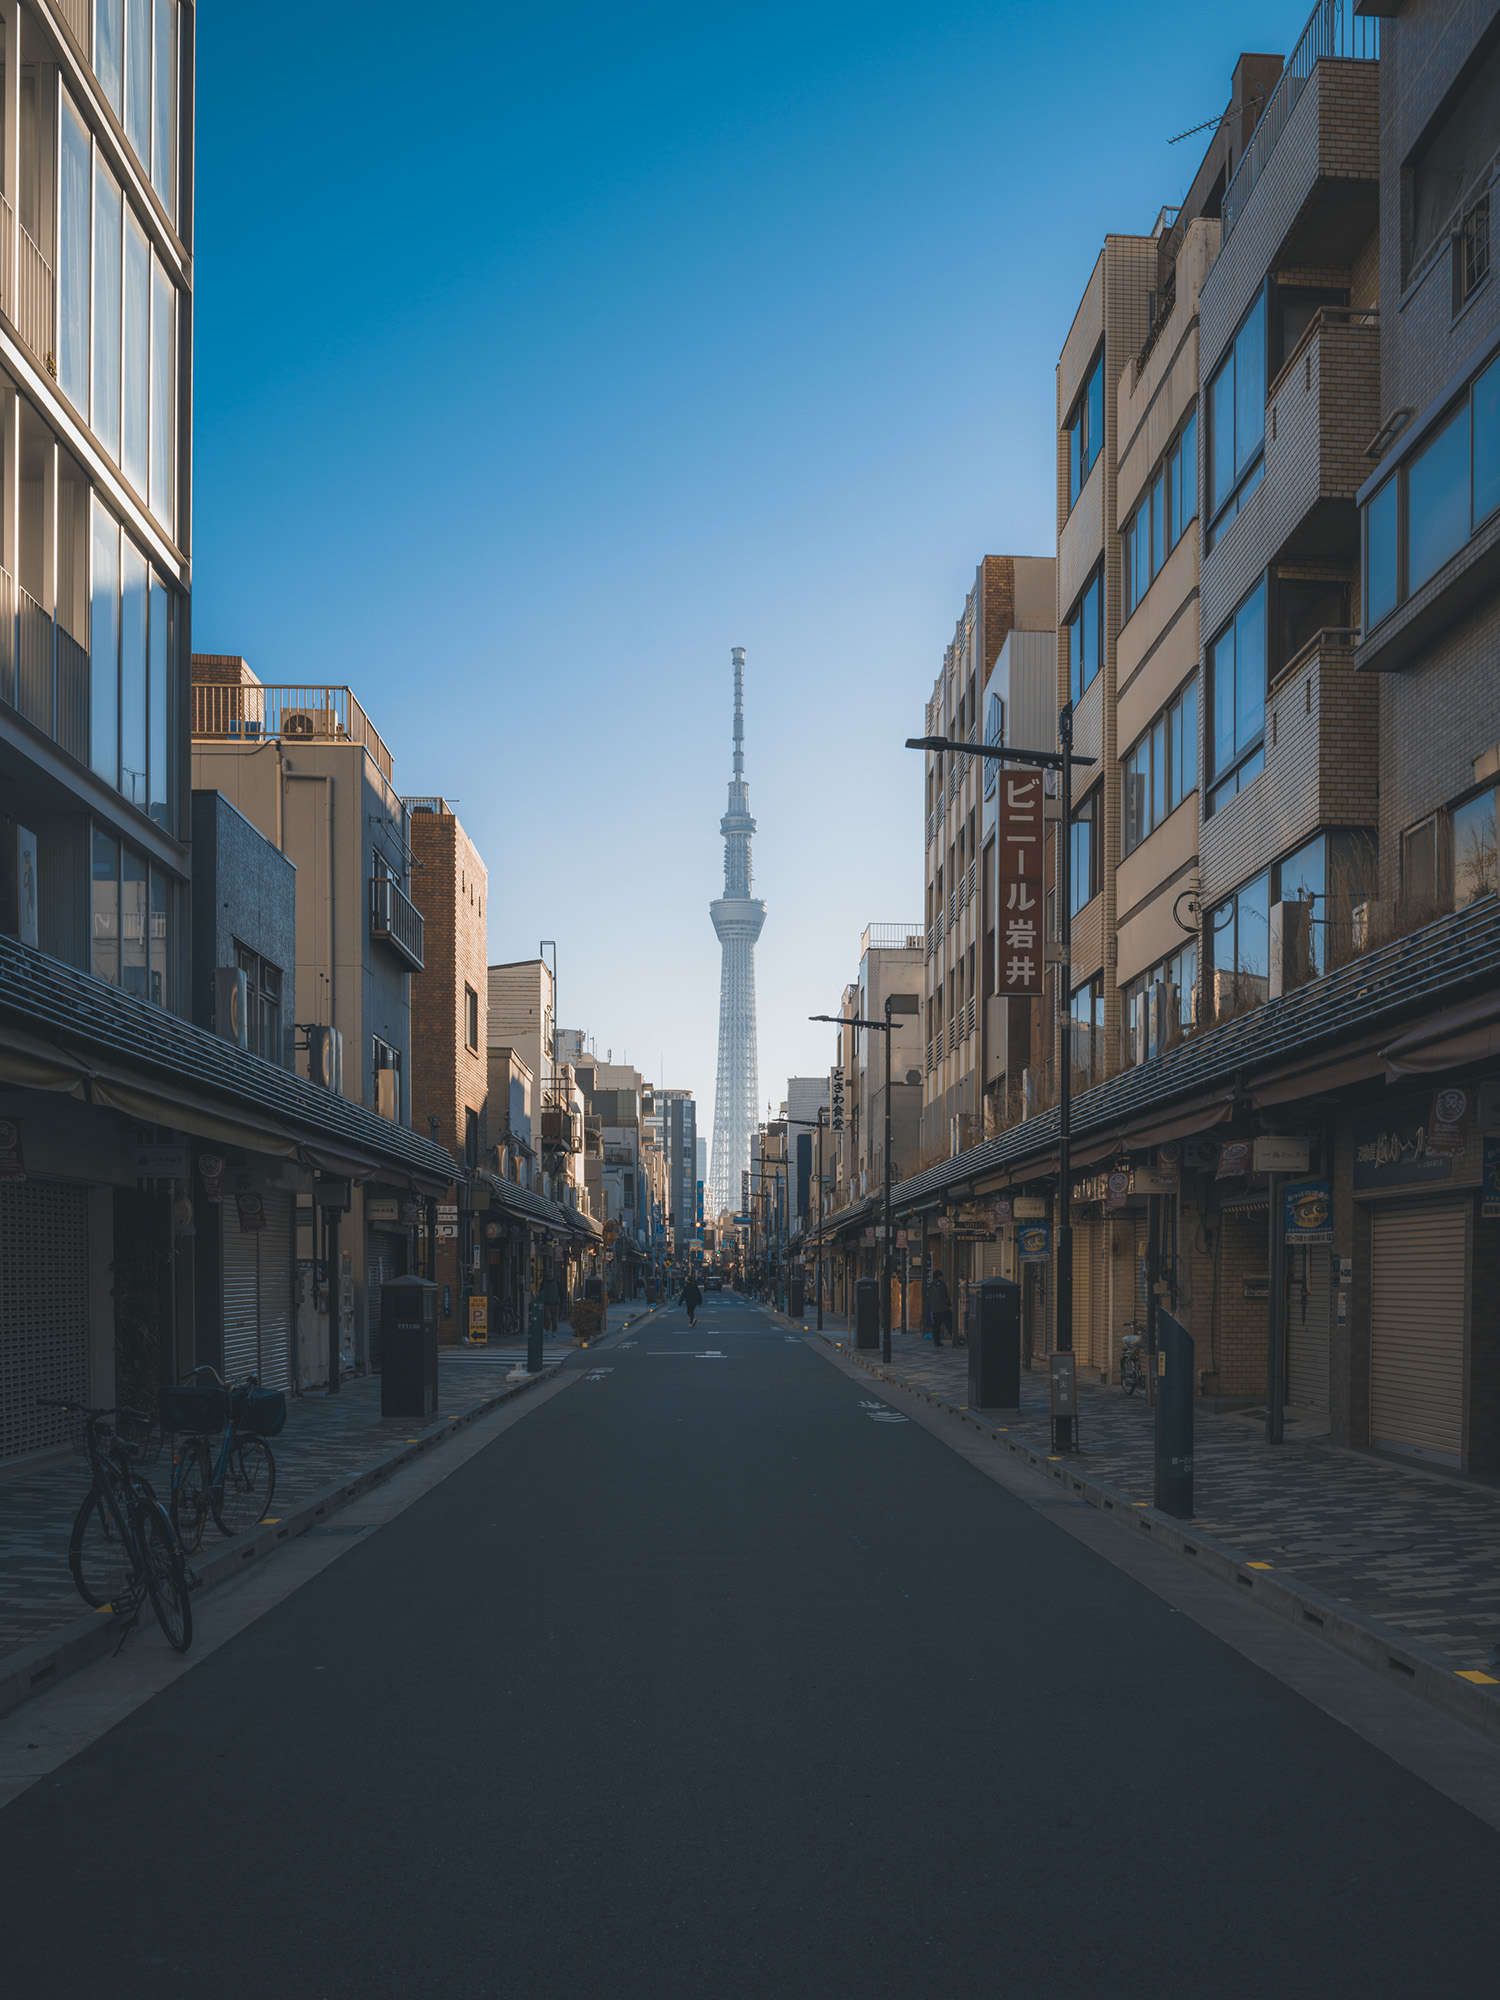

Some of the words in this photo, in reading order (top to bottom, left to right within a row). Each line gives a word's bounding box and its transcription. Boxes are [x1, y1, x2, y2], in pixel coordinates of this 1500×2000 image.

[1006, 778, 1040, 986] ビニール岩井
[832, 1070, 845, 1131] とさわ食堂
[473, 1310, 483, 1322] P
